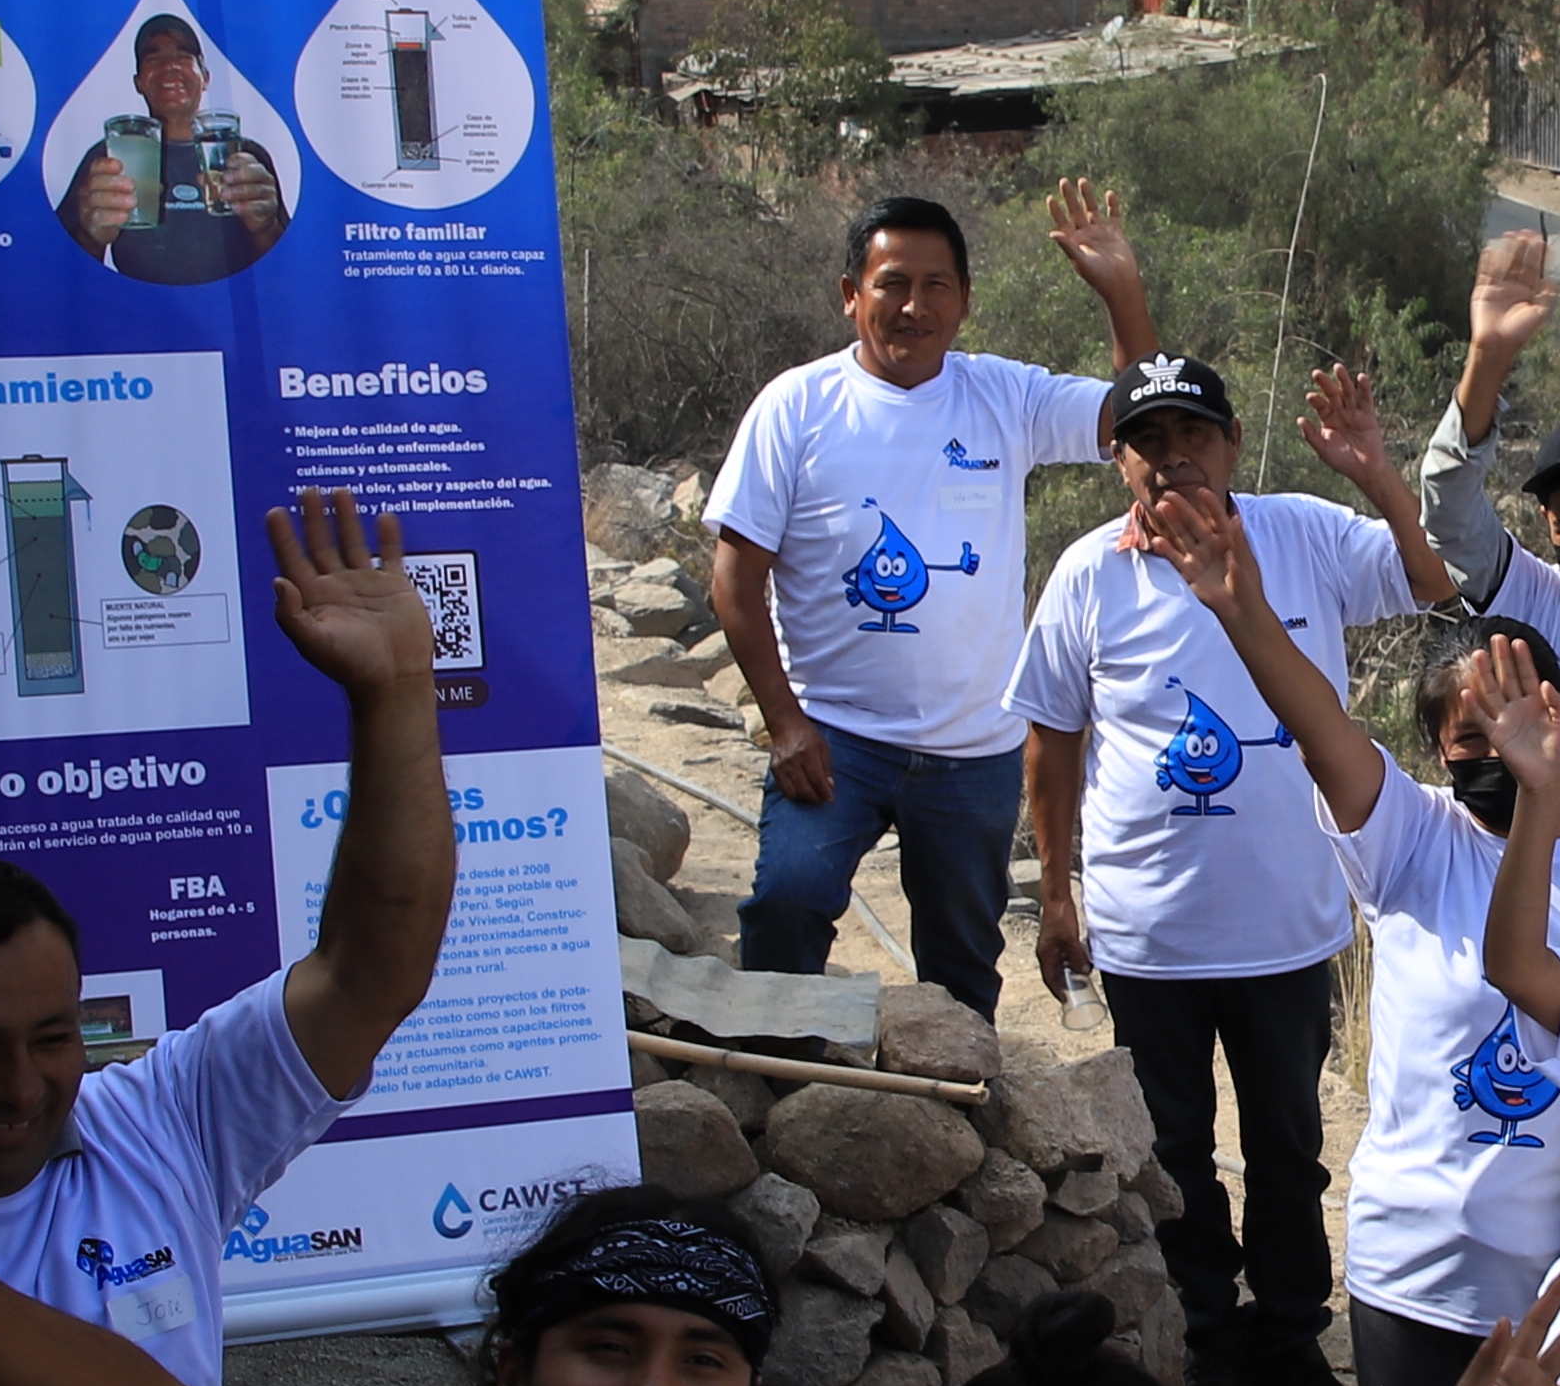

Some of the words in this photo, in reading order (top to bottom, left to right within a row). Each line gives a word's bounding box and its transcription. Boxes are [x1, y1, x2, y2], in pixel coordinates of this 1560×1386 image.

[344, 222, 401, 241] Filtro
[404, 222, 486, 240] familiar
[342, 248, 416, 261] Tratamiento
[417, 249, 433, 261] de
[435, 250, 466, 263] agua
[468, 250, 509, 260] casero
[510, 250, 545, 262] capaz
[343, 265, 360, 277] de
[363, 264, 415, 278] producir
[416, 264, 432, 276] 60
[433, 266, 442, 276] a
[444, 263, 459, 276] 80
[462, 264, 478, 275] Lt.
[480, 263, 524, 275] diarios.
[280, 362, 487, 398] Beneficios
[1130, 377, 1203, 402] adidas
[294, 425, 339, 439] Mejora
[341, 424, 358, 436] de
[360, 422, 408, 435] calidad
[410, 421, 426, 433] de
[428, 422, 462, 435] agua.
[296, 442, 375, 457] Disminución
[377, 442, 394, 454] de
[396, 440, 485, 453] enfermedades
[296, 463, 355, 476] cutáneas
[357, 465, 365, 477] y
[368, 460, 452, 474] estomacales.
[365, 482, 395, 494] olor,
[397, 480, 433, 492] sabor
[435, 481, 443, 493] y
[445, 478, 494, 492] aspecto
[496, 477, 516, 489] del
[518, 477, 552, 490] agua.
[370, 504, 378, 515] y
[380, 500, 410, 514] facil
[450, 686, 473, 701] ME
[37, 755, 206, 799] objetivo
[49, 821, 58, 831] a
[61, 819, 94, 833] agua
[96, 813, 143, 828] tratada
[146, 812, 163, 825] de
[165, 808, 213, 823] calidad
[216, 809, 240, 822] que
[453, 807, 569, 844] omos?
[28, 836, 40, 849] el
[44, 833, 97, 849] servicio
[99, 831, 116, 844] de
[119, 831, 152, 845] agua
[155, 825, 204, 843] potable
[206, 826, 223, 837] en
[226, 822, 242, 835] 10
[244, 824, 252, 834] a
[468, 866, 506, 880] desde
[508, 865, 520, 877] el
[522, 862, 550, 876] 2008
[170, 874, 226, 900] FBA
[456, 886, 471, 897] de
[474, 884, 504, 897] agua
[507, 878, 552, 894] potable
[554, 878, 578, 890] que
[149, 907, 205, 921] Hogares
[207, 904, 224, 916] de
[226, 902, 236, 914] 4
[246, 901, 254, 913] 5
[459, 900, 491, 912] Perú.
[495, 897, 534, 910] Según
[150, 927, 217, 943] personas.
[479, 1180, 585, 1212] CAWST
[223, 1227, 362, 1264] AguaSAN
